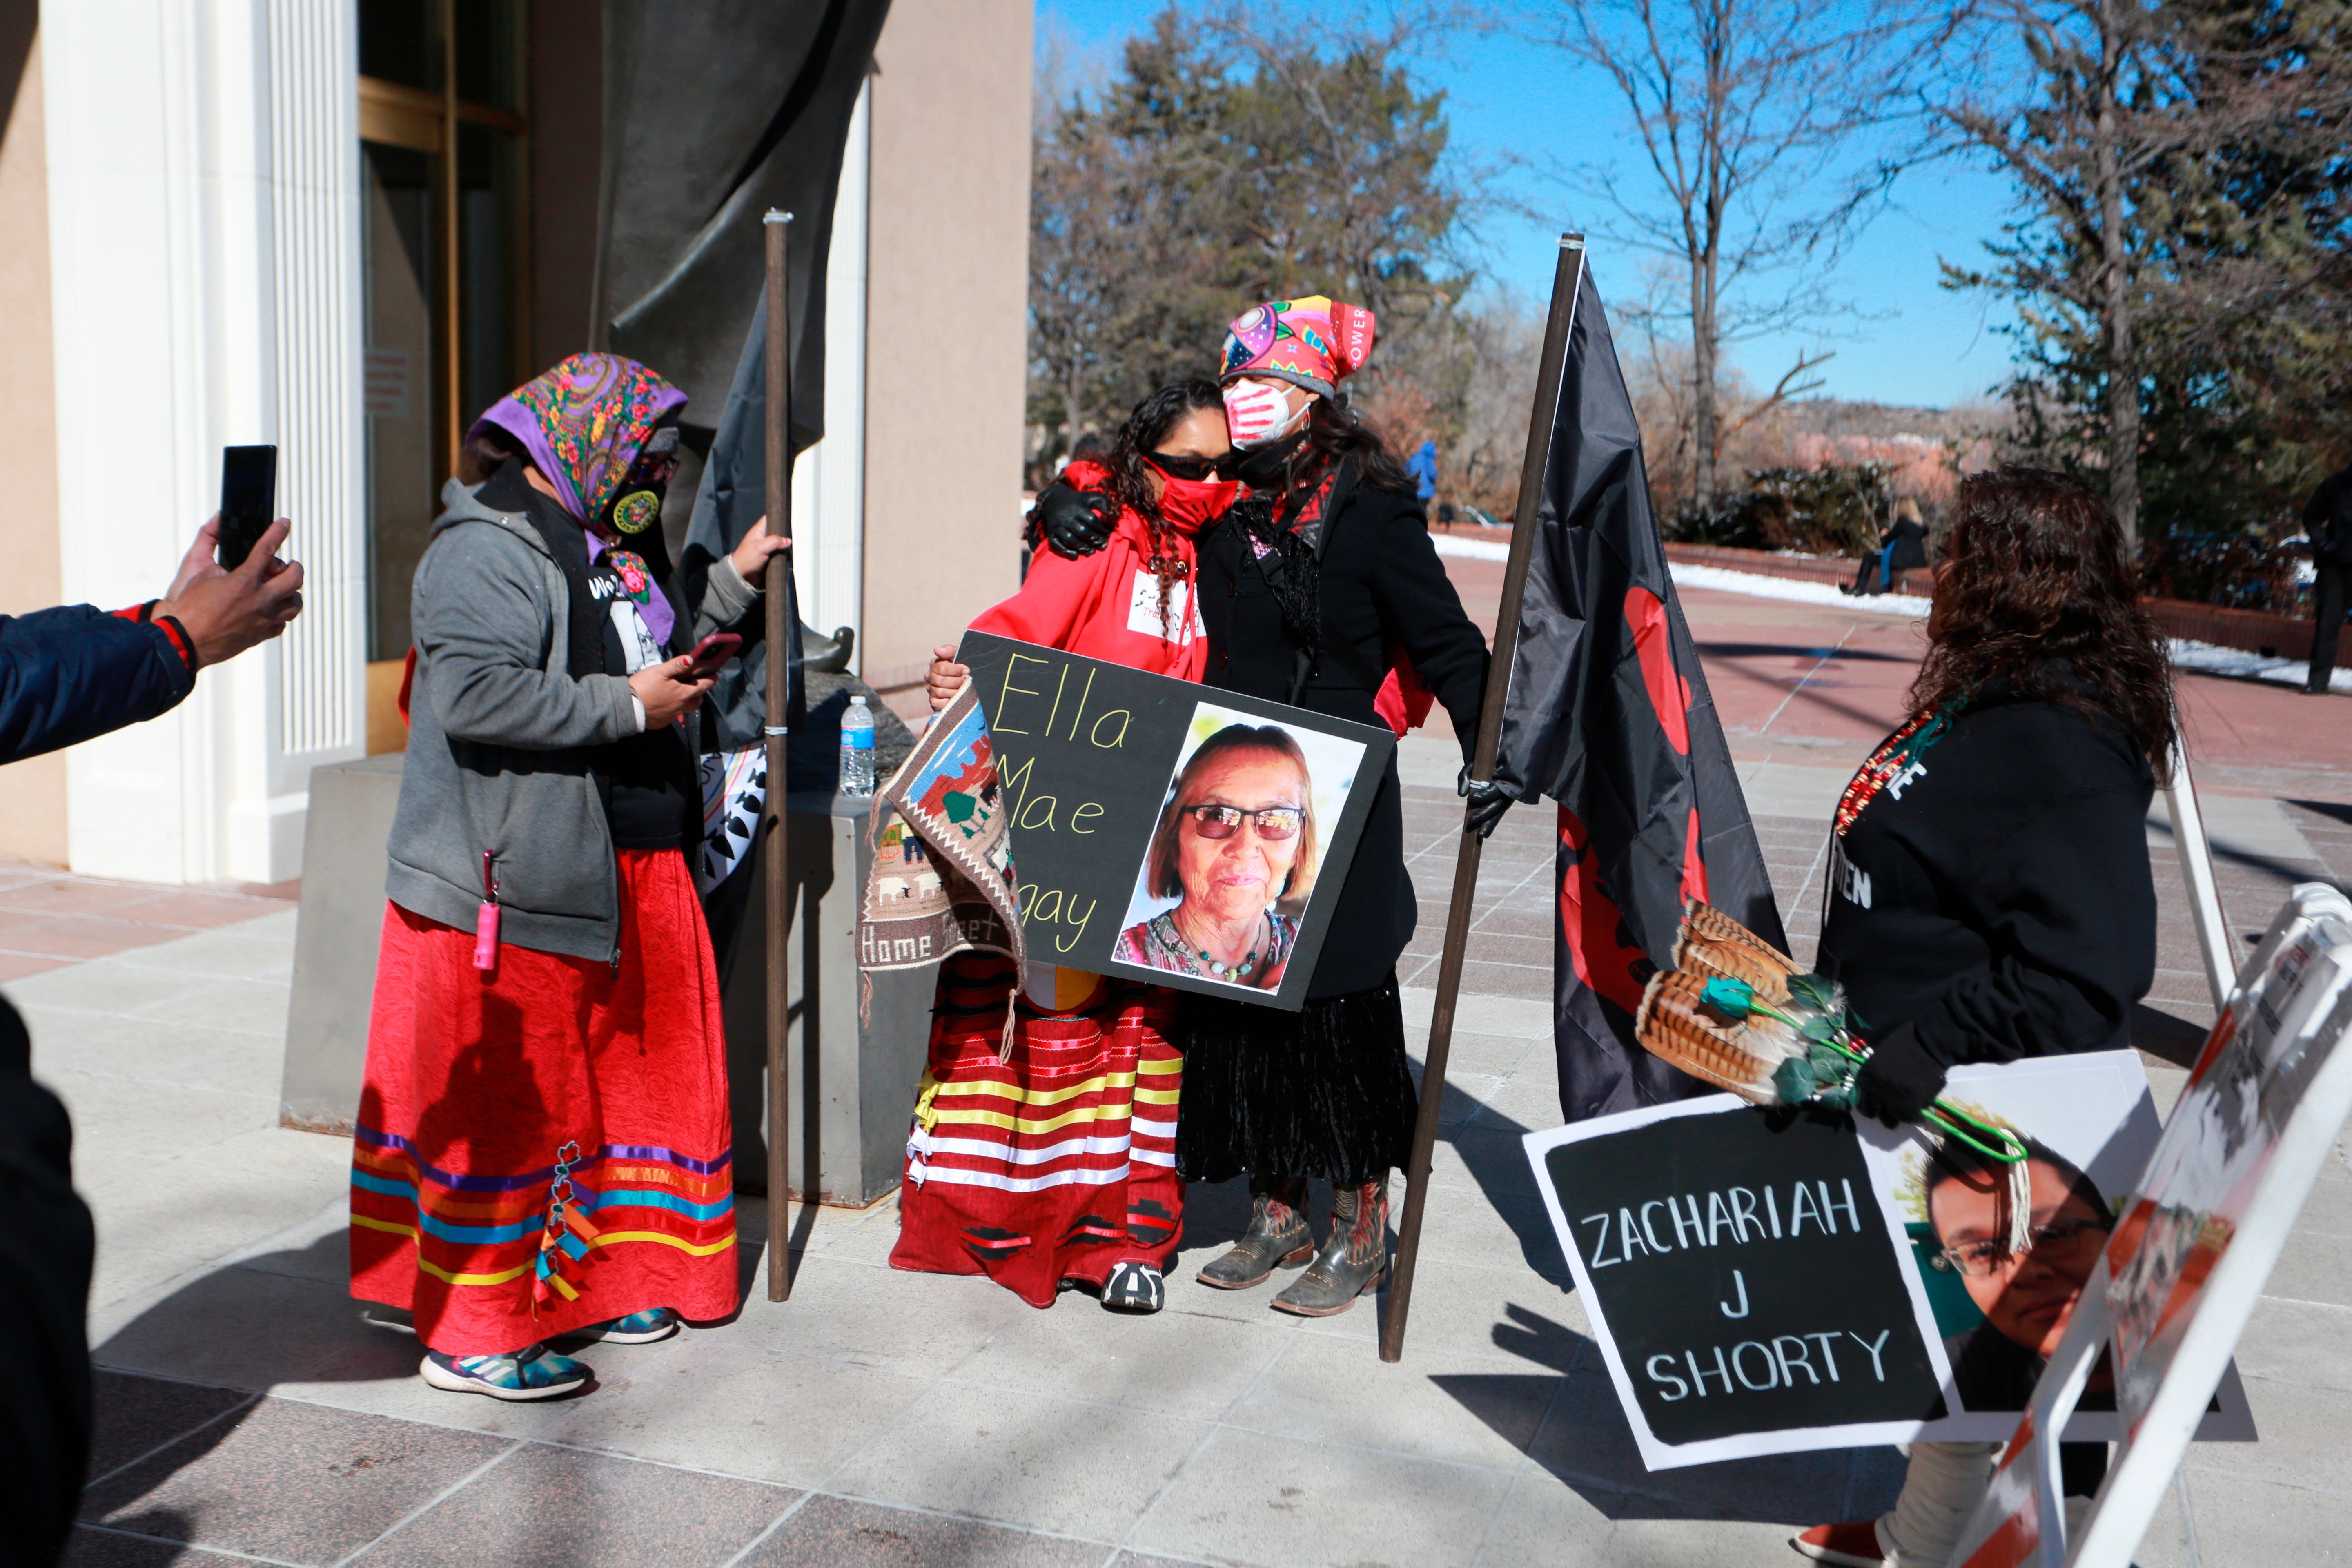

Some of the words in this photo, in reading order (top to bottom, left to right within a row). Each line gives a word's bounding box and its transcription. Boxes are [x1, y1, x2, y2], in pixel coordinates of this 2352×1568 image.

[1350, 309, 1365, 371] POWER
[993, 653, 1130, 748] Ella
[996, 754, 1104, 834] Mae
[862, 925, 931, 963] Home
[1581, 1178, 1861, 1269] ZACHARIAH
[1720, 1269, 1749, 1319] J
[1646, 1329, 1890, 1401] SHORTY
